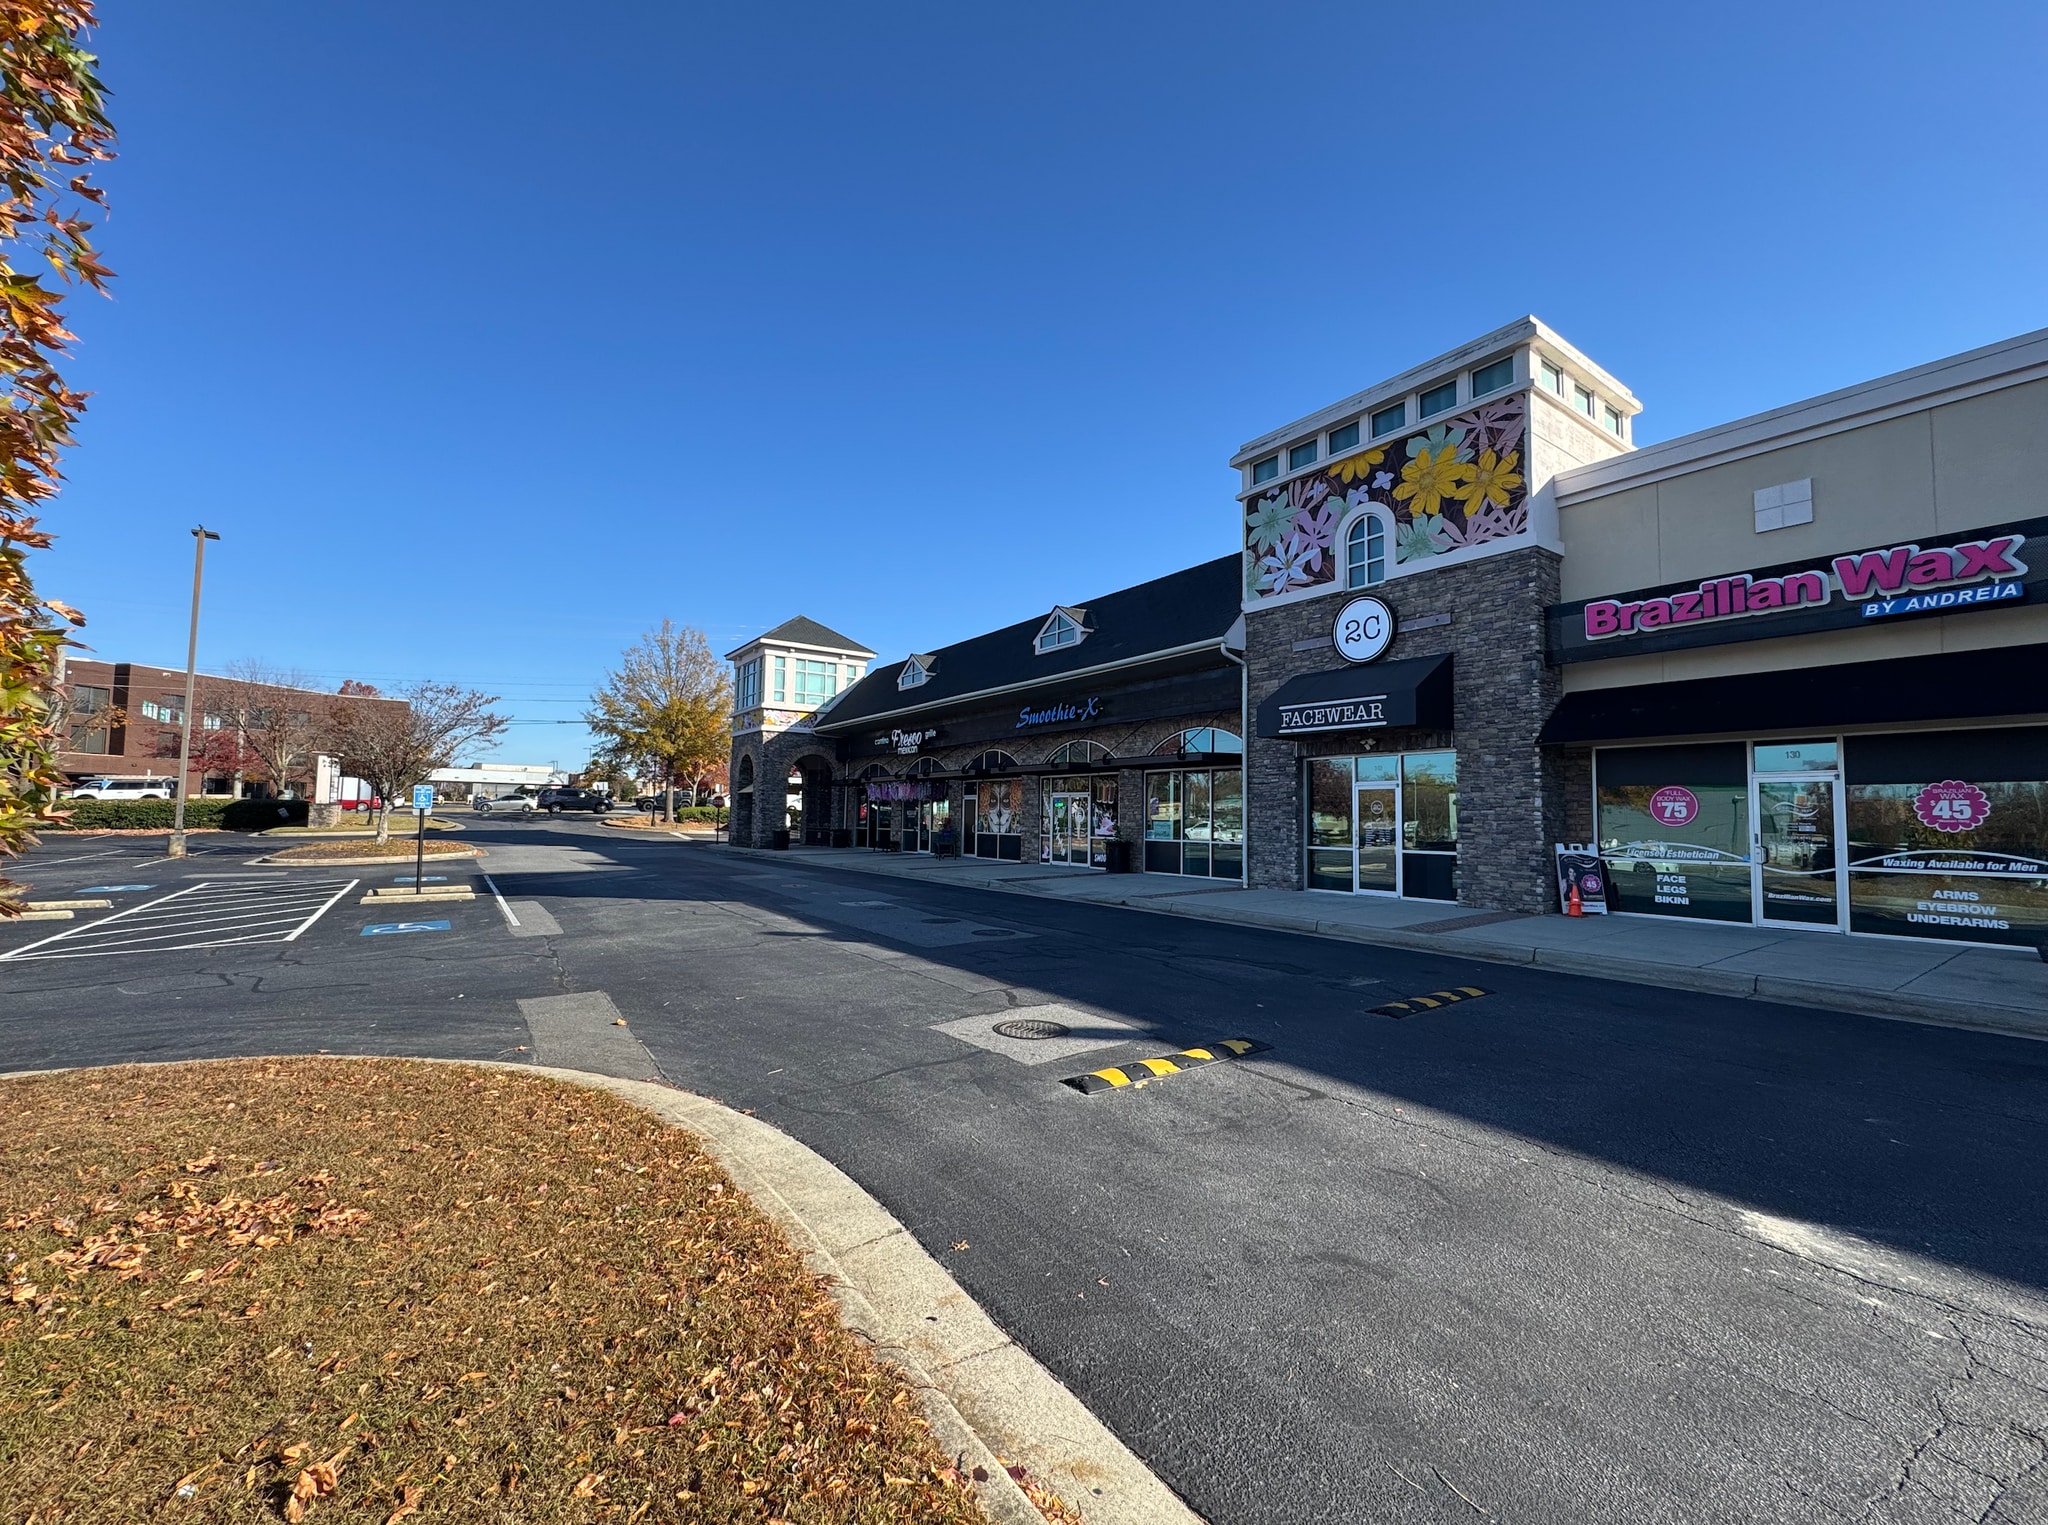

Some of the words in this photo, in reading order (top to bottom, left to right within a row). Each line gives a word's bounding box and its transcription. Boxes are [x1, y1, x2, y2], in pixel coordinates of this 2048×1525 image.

[1585, 571, 1827, 638] Brazilian
[1832, 536, 2022, 598] Wax
[1865, 601, 1896, 617] BY
[1905, 583, 2018, 610] ANDREIA
[1344, 614, 1381, 645] 2C
[1016, 697, 1099, 728] Smoothie-X
[1280, 702, 1385, 728] FACEWEAR
[1785, 750, 1801, 760] 130
[1626, 848, 1665, 858] Licensed
[1666, 849, 1720, 860] Esthetician
[1883, 858, 1925, 870] Waxing
[1927, 859, 1985, 871] Available
[1986, 861, 2006, 872] for
[2008, 861, 2039, 873] Men
[1656, 874, 1687, 884] FACE
[1656, 884, 1687, 894] LEGS
[1932, 889, 1979, 901] ARMS
[1654, 895, 1690, 905] BIKINI
[1917, 901, 1997, 916] EYEBROW
[1906, 913, 2010, 930] UNDERARMS
